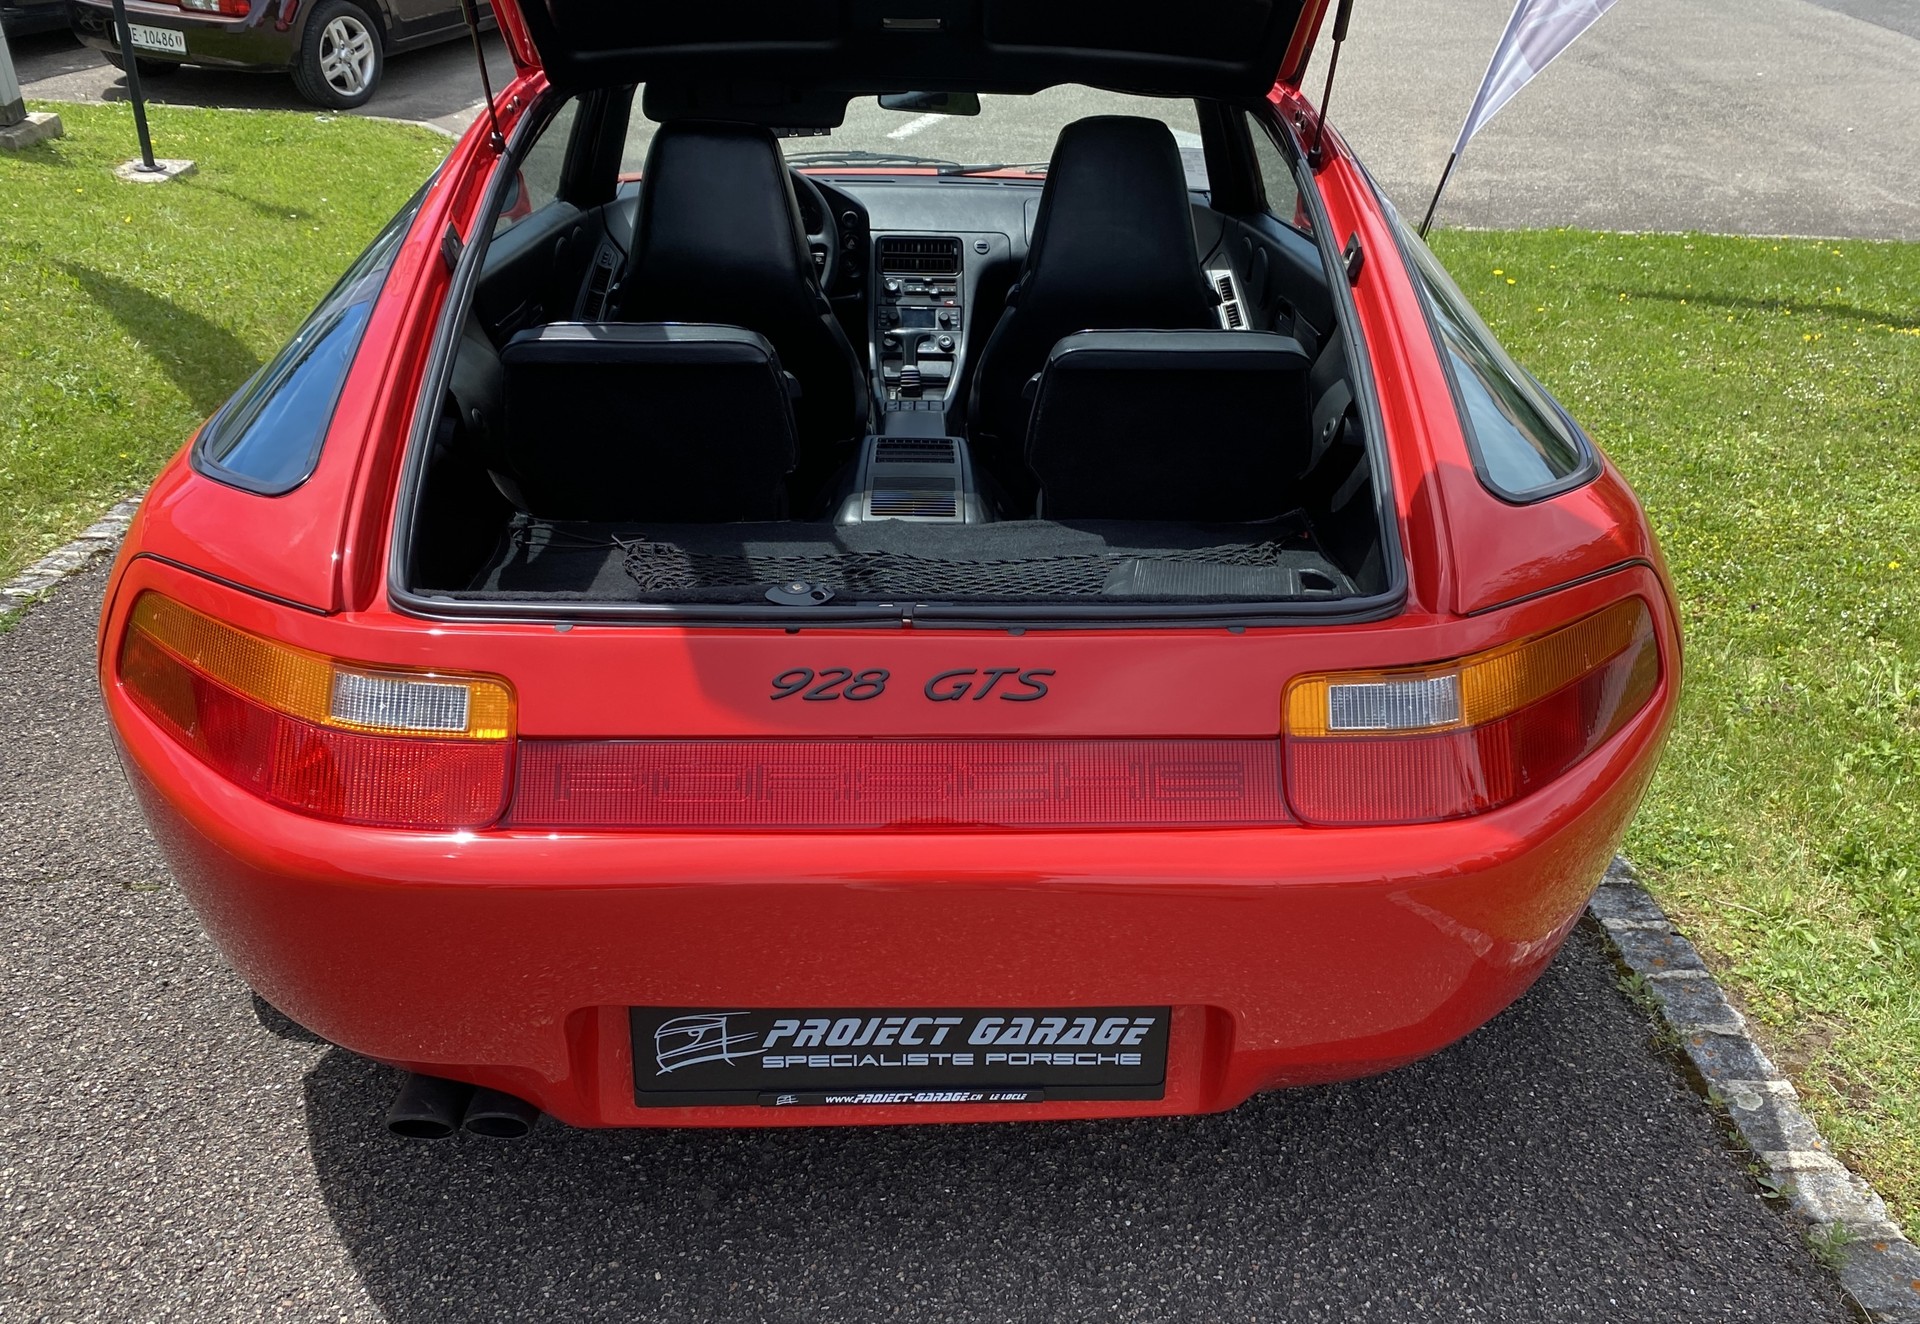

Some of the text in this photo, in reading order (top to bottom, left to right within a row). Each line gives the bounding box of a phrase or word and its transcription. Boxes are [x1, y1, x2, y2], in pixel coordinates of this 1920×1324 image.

[770, 667, 1057, 701] 928 GTS
[553, 762, 1244, 802] PORSCHE
[762, 1017, 1156, 1048] PROJECT GARAGE
[762, 1053, 1142, 1069] SPECIALISTE PORSCHE
[1001, 1093, 1028, 1101] LOCLE
